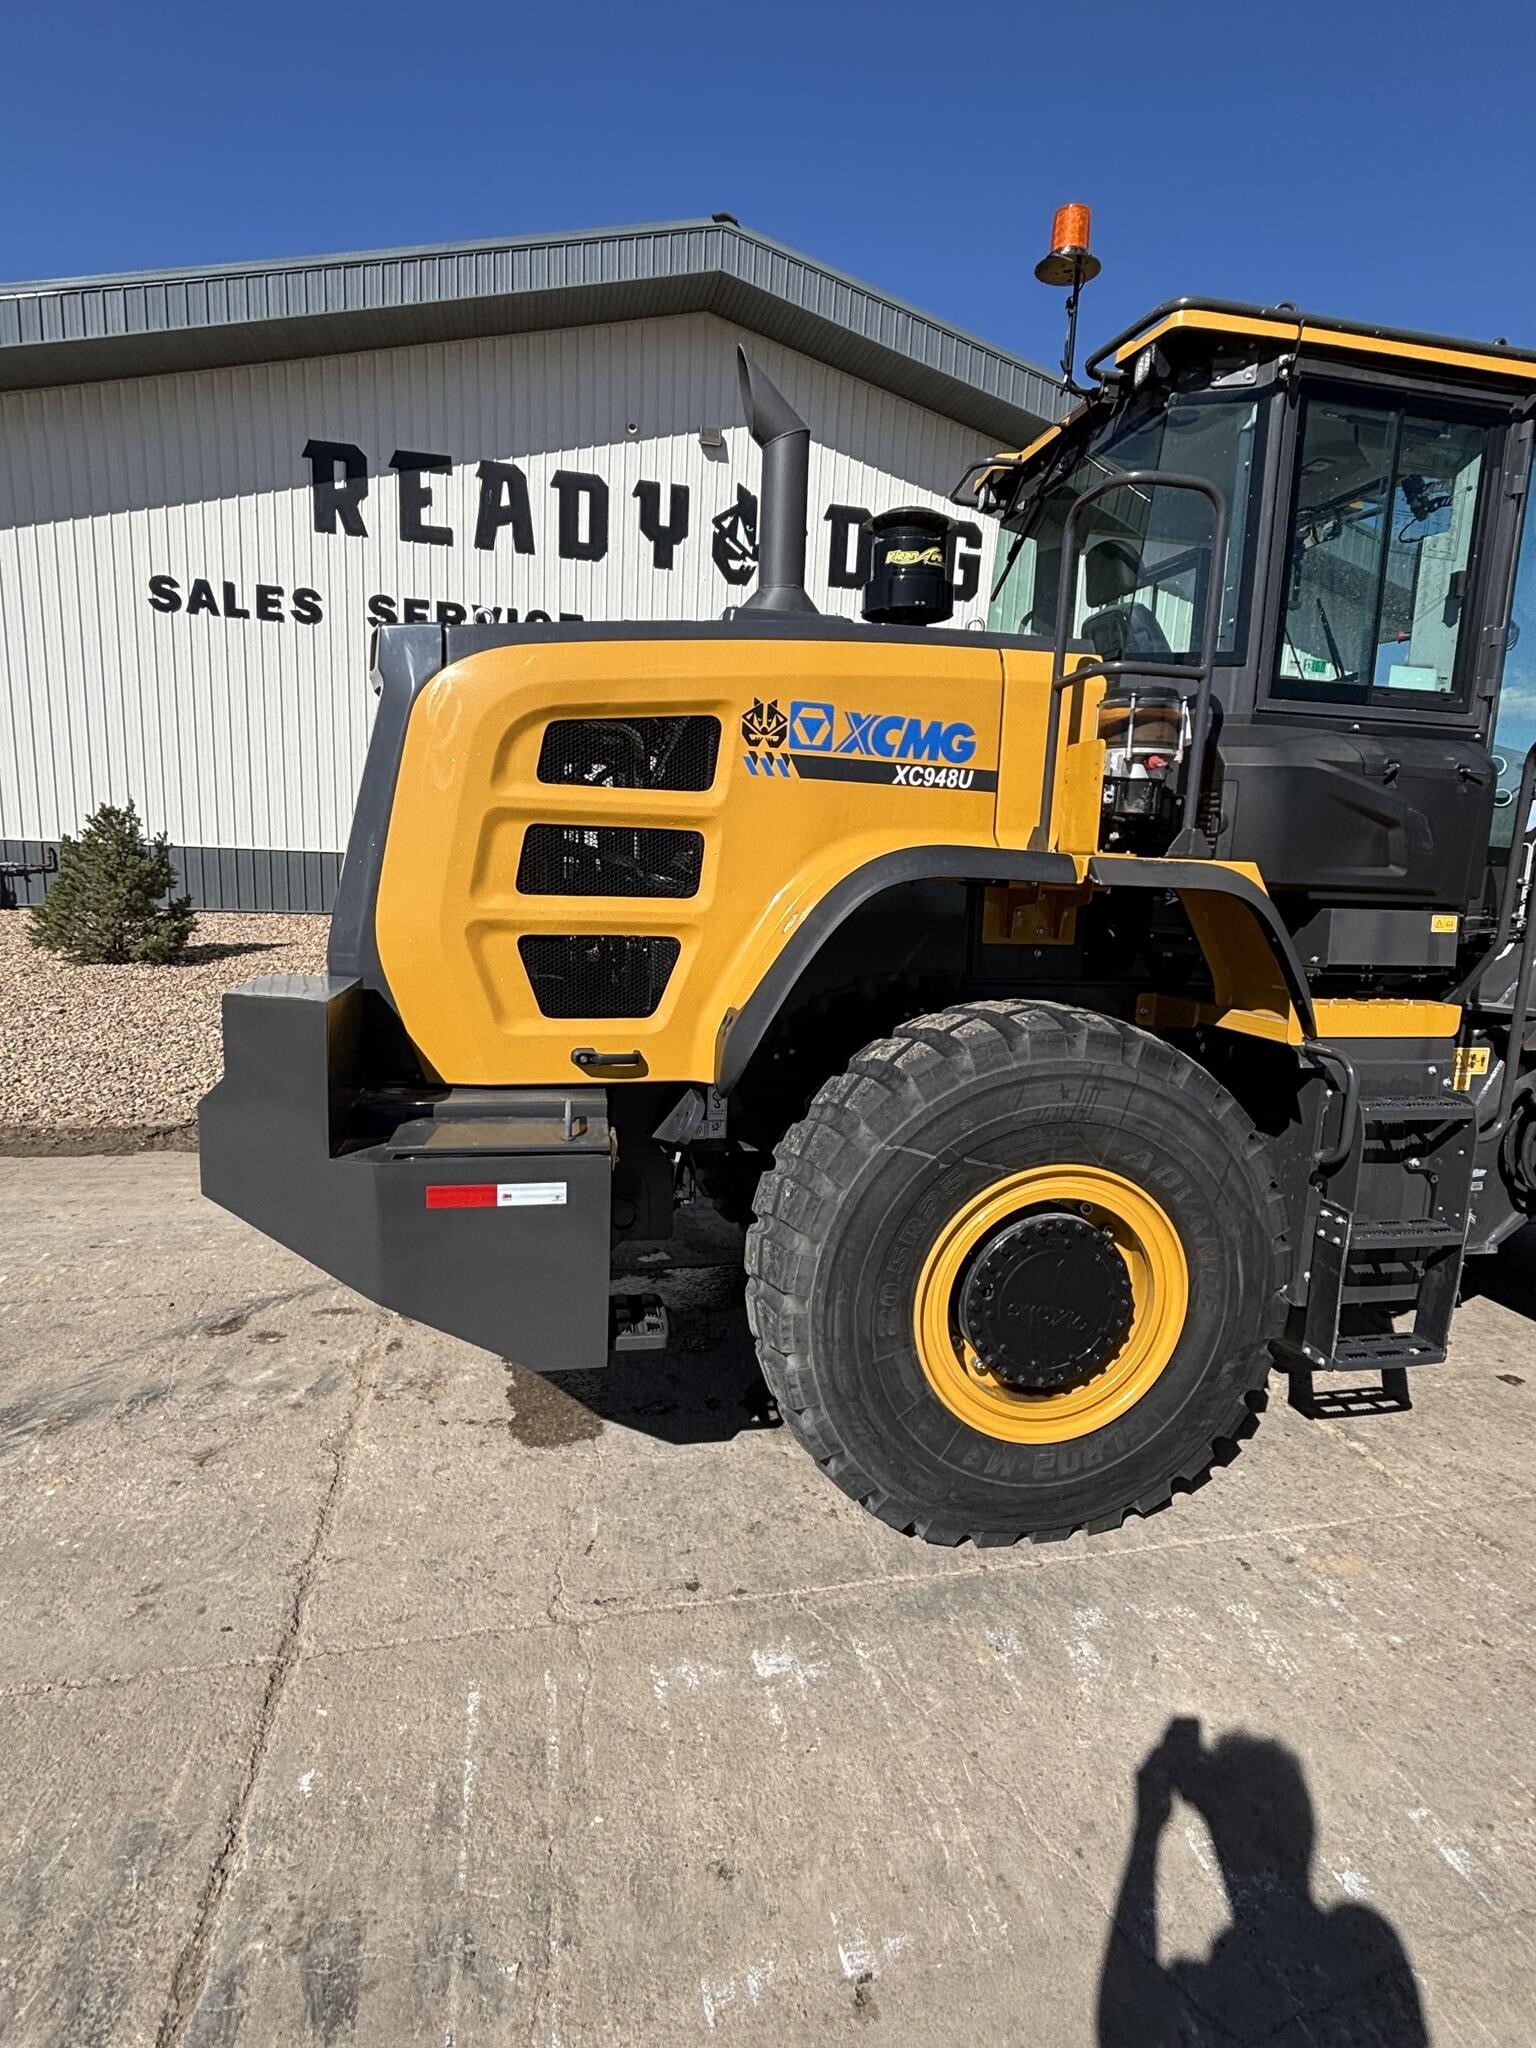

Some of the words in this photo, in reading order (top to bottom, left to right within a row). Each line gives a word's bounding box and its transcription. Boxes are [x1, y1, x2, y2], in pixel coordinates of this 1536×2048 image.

[302, 439, 690, 570] READY
[824, 503, 982, 603] DG
[148, 575, 324, 625] SALES
[834, 711, 976, 763] XCMG
[892, 765, 974, 790] XC948U
